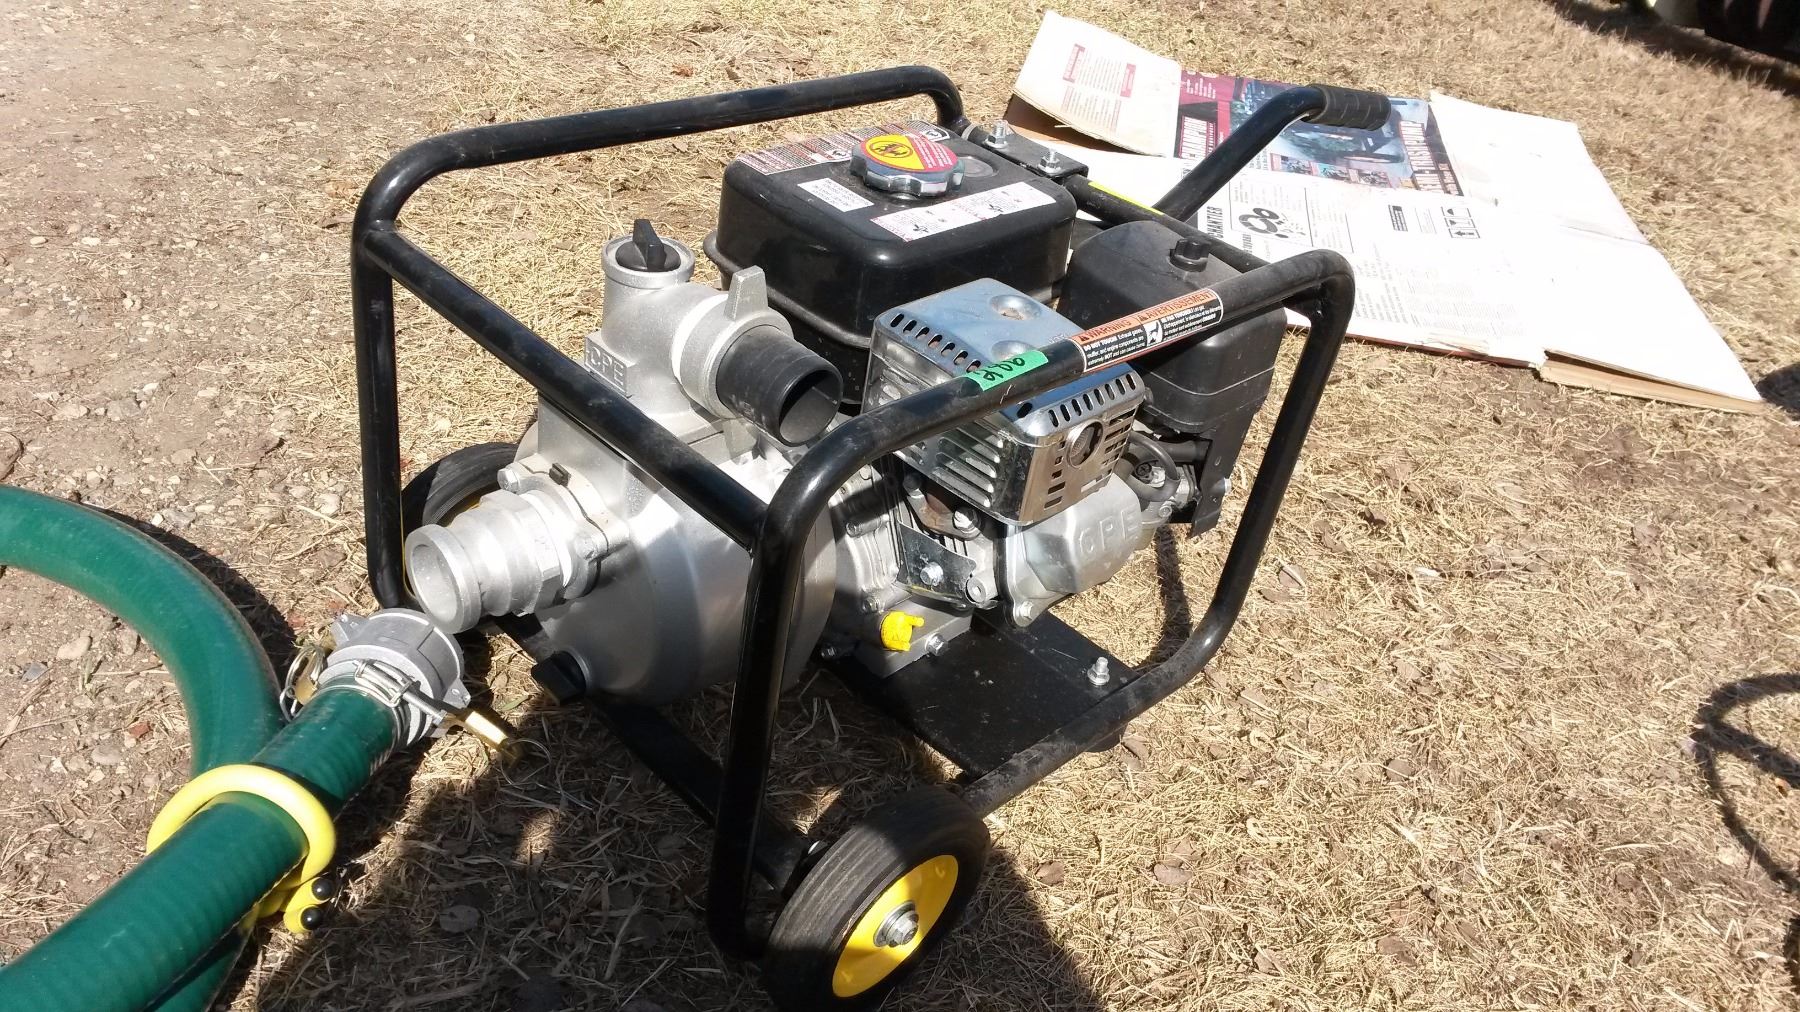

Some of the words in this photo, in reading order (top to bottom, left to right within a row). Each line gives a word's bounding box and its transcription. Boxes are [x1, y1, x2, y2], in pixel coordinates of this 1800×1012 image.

[1182, 116, 1206, 158] CHAMPION
[1399, 121, 1425, 144] PUMP
[1147, 291, 1213, 319] AVERTISSEMENT
[1088, 317, 1131, 338] WARNING
[590, 346, 623, 386] CPE
[1079, 504, 1140, 556] CPE
